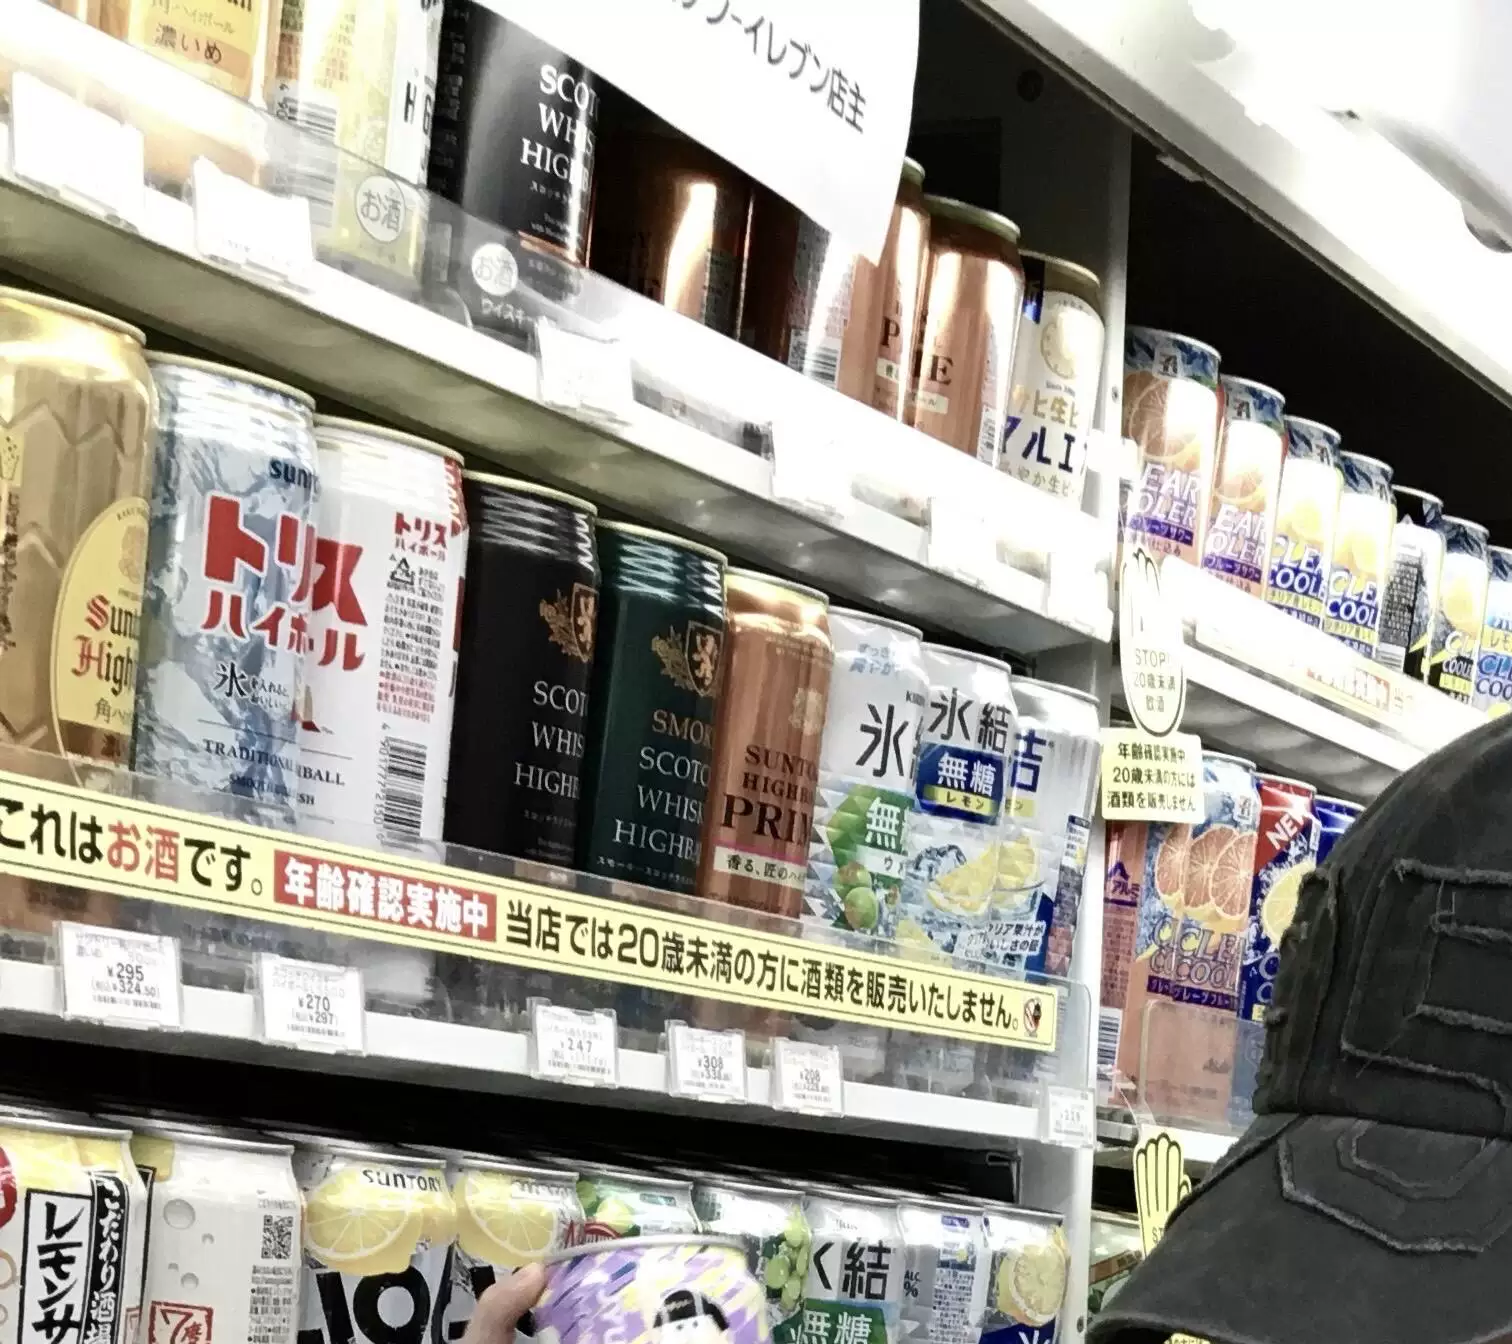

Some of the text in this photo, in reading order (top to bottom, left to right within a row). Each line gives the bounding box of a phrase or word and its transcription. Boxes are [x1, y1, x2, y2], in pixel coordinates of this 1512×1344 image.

[155, 22, 223, 64] 濃いめ
[394, 511, 449, 549] トリス
[203, 494, 370, 628] トリス
[213, 662, 249, 699] 氷
[928, 686, 1012, 751] 氷結
[937, 751, 997, 798] 無糖
[1117, 743, 1187, 766] 年齢確認実施中
[1112, 765, 1196, 790] 20歳未満の方には
[946, 791, 985, 810] レモン
[0, 799, 264, 897] これはお酒です。
[284, 857, 491, 939] 年齢確認実施中
[107, 963, 145, 983] ¥295
[505, 903, 1020, 1033] 当店では20歳未満の方に酒類を販売いたしません。
[298, 993, 331, 1013] ¥270
